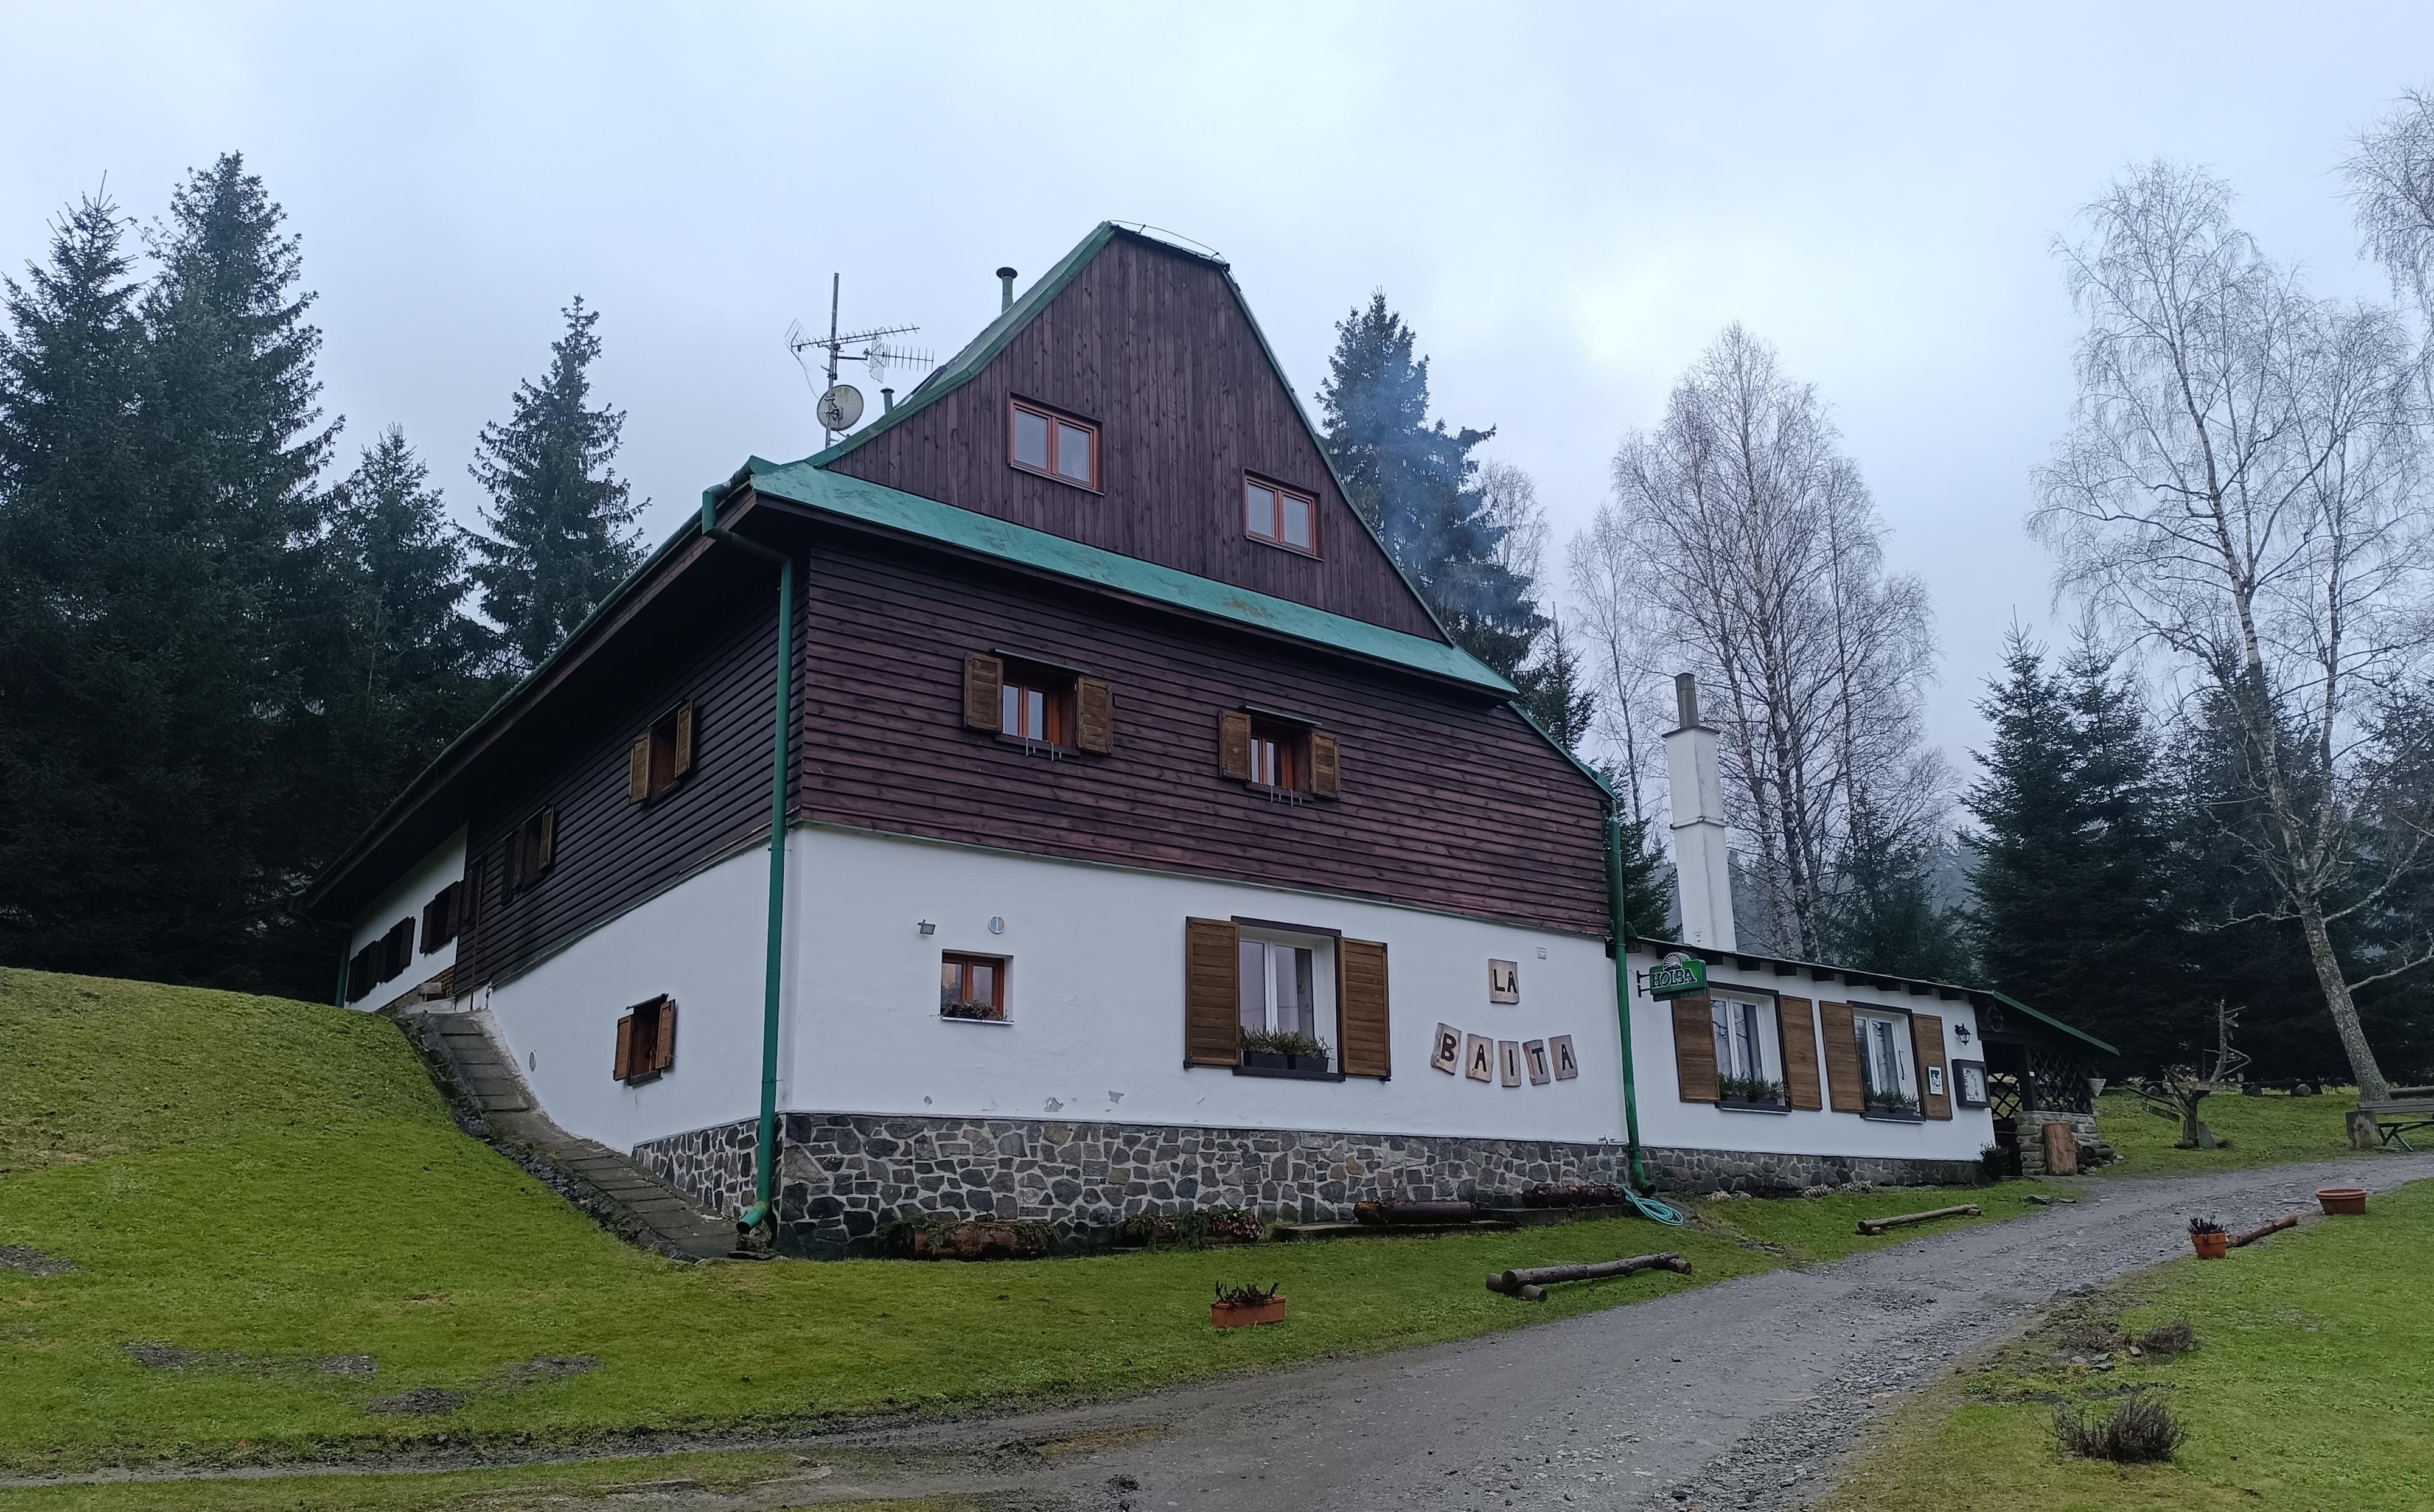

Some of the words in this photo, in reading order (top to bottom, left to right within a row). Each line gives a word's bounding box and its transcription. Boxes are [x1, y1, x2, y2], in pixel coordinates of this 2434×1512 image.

[1493, 969, 1518, 994] LA
[1650, 968, 1698, 988] HOLBA
[1440, 1033, 1574, 1076] BAITA
